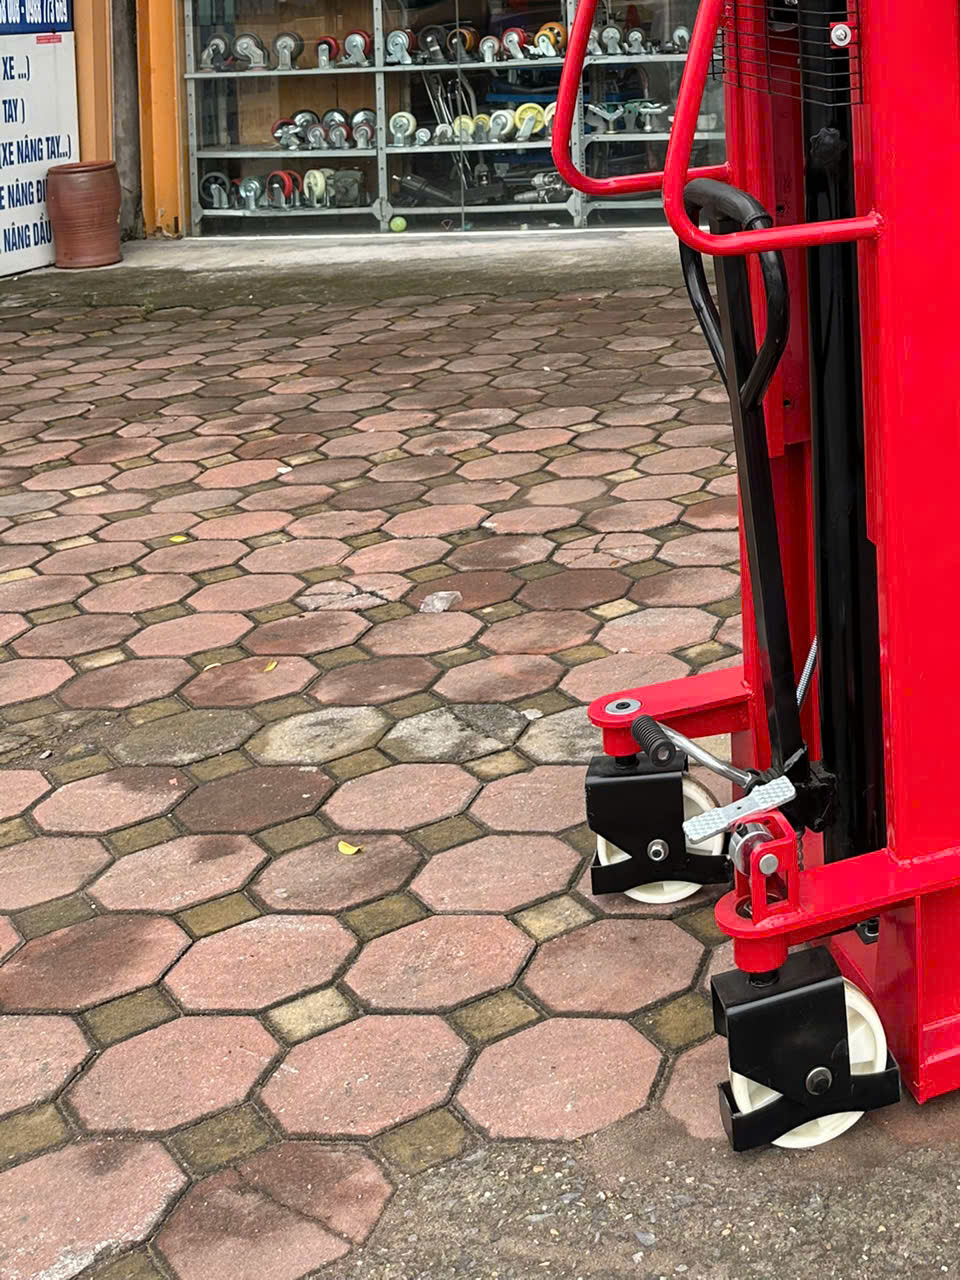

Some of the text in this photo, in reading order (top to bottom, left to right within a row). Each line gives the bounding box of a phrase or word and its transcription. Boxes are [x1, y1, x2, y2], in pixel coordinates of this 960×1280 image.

[2, 55, 15, 81] XE
[2, 98, 18, 123] TAY
[17, 134, 43, 164] NÂNG
[8, 178, 34, 208] NÂNG
[4, 221, 31, 252] NÂNG
